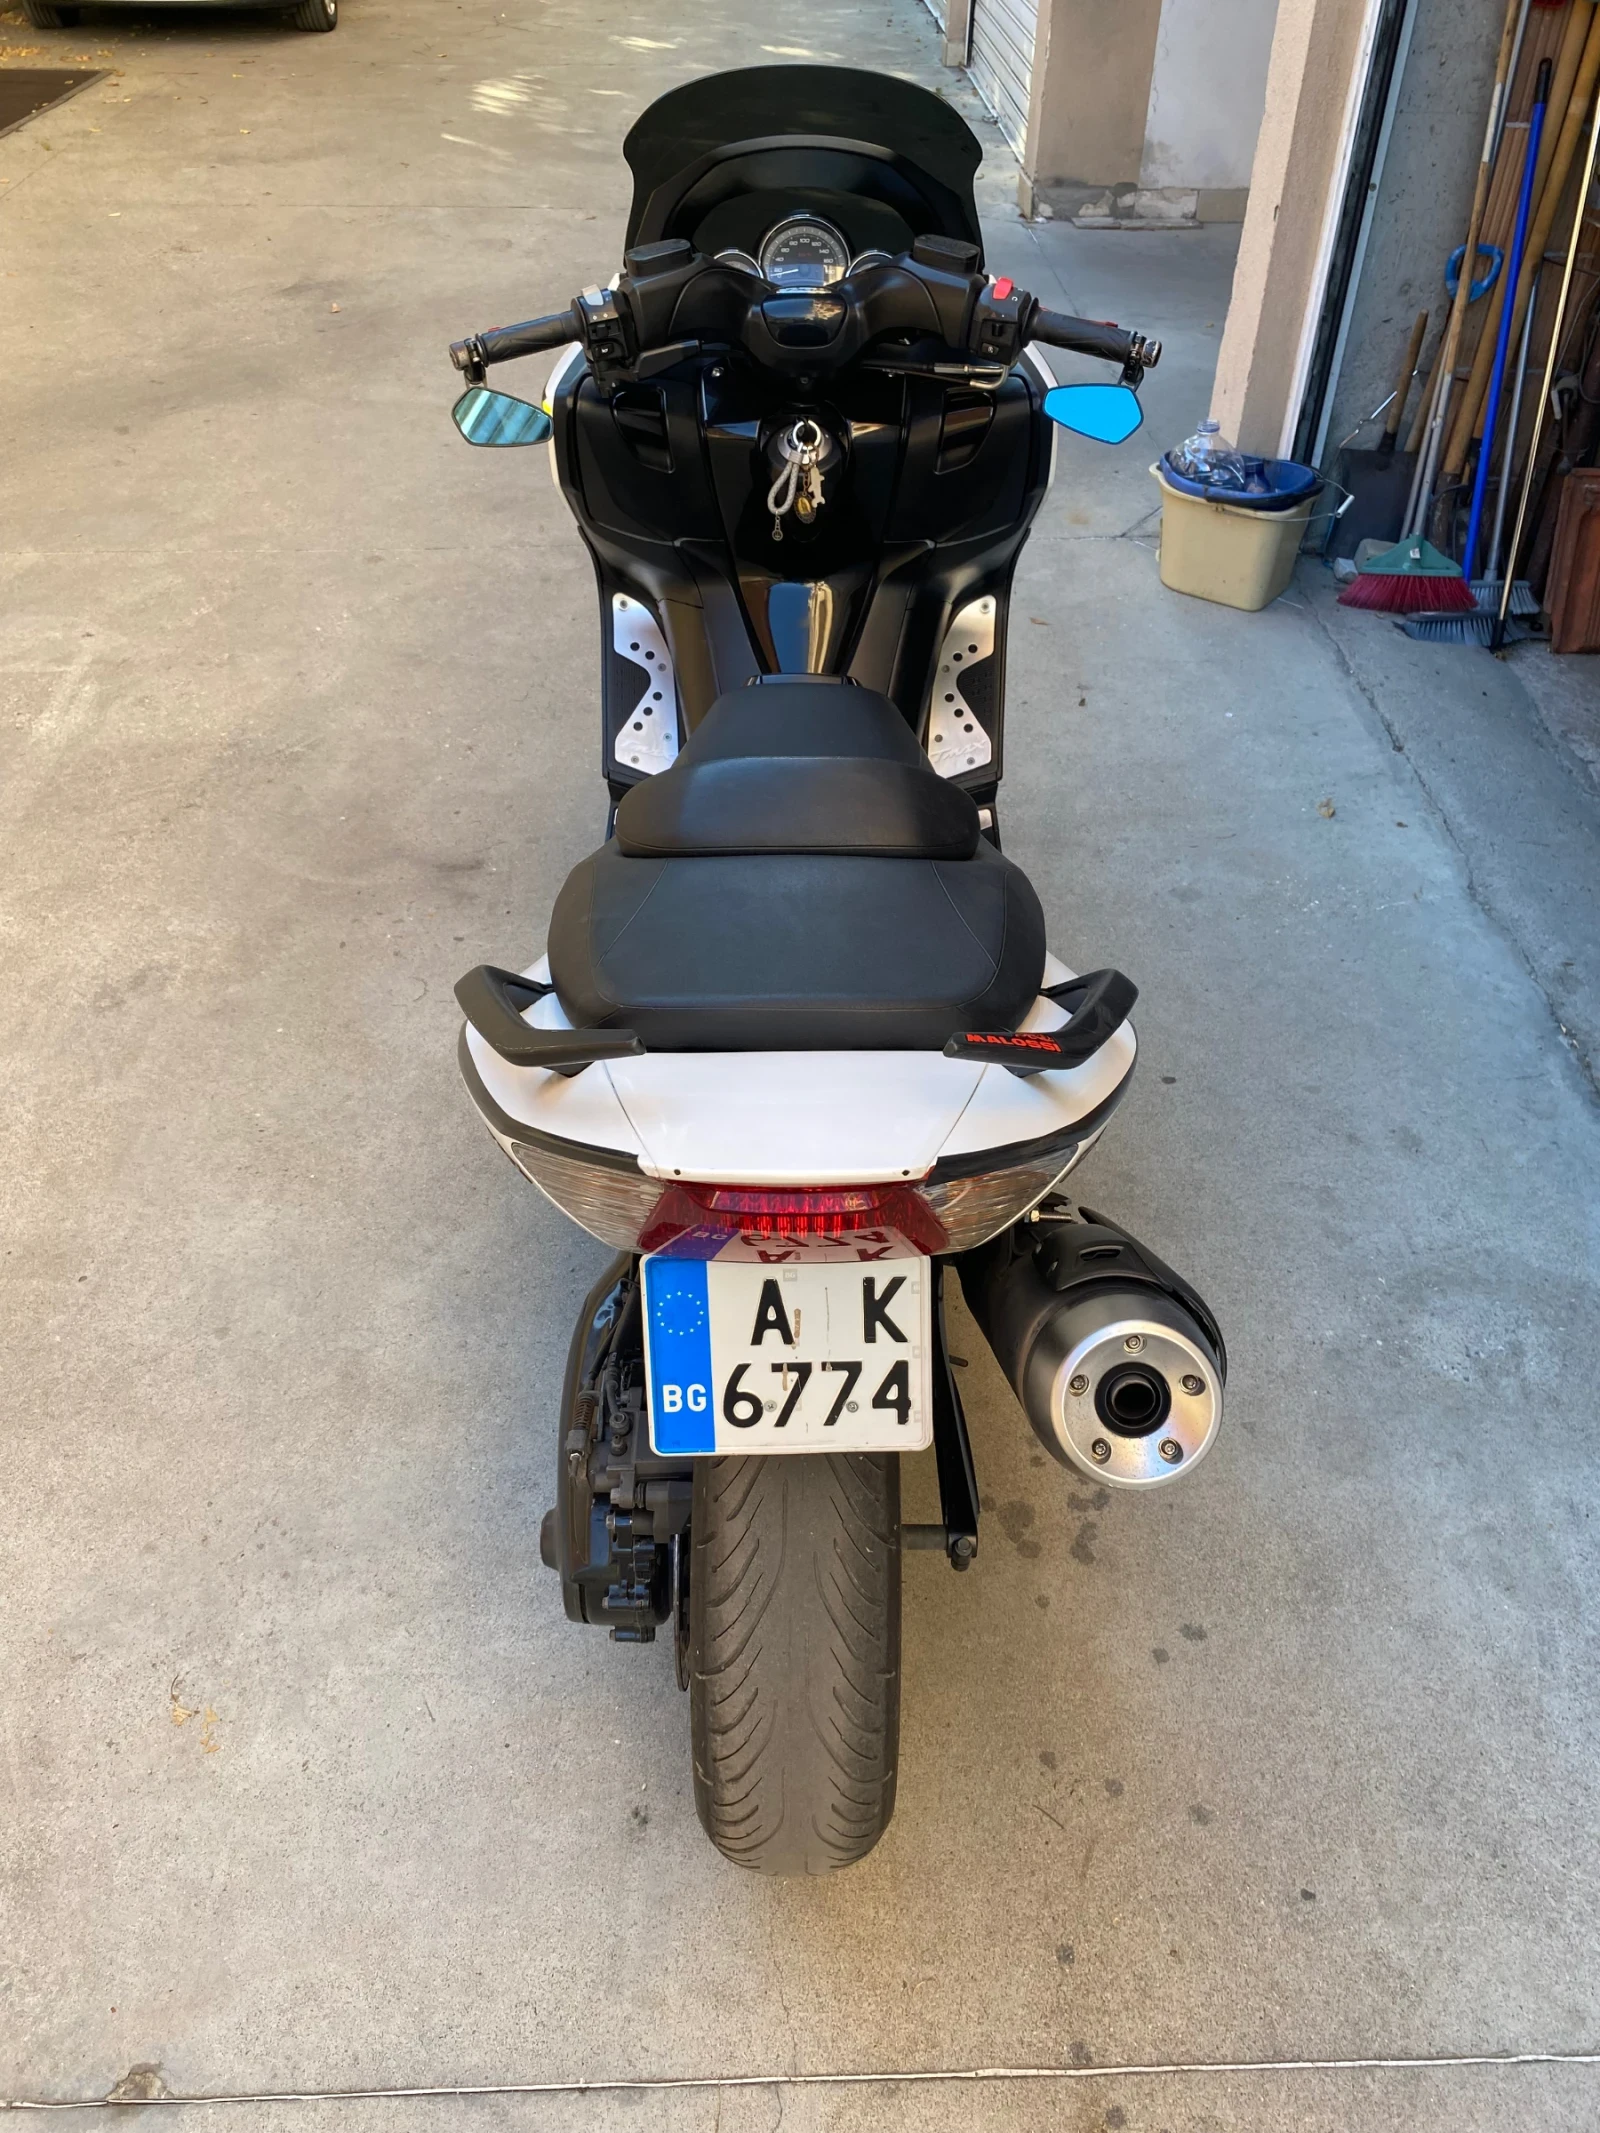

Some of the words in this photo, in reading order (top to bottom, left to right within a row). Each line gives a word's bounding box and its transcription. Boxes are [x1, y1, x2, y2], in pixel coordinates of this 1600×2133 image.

[967, 1033, 1062, 1052] MALOSSI
[750, 1276, 796, 1346] A
[862, 1275, 909, 1344] K
[662, 1383, 707, 1413] BG
[722, 1359, 912, 1428] 6774
